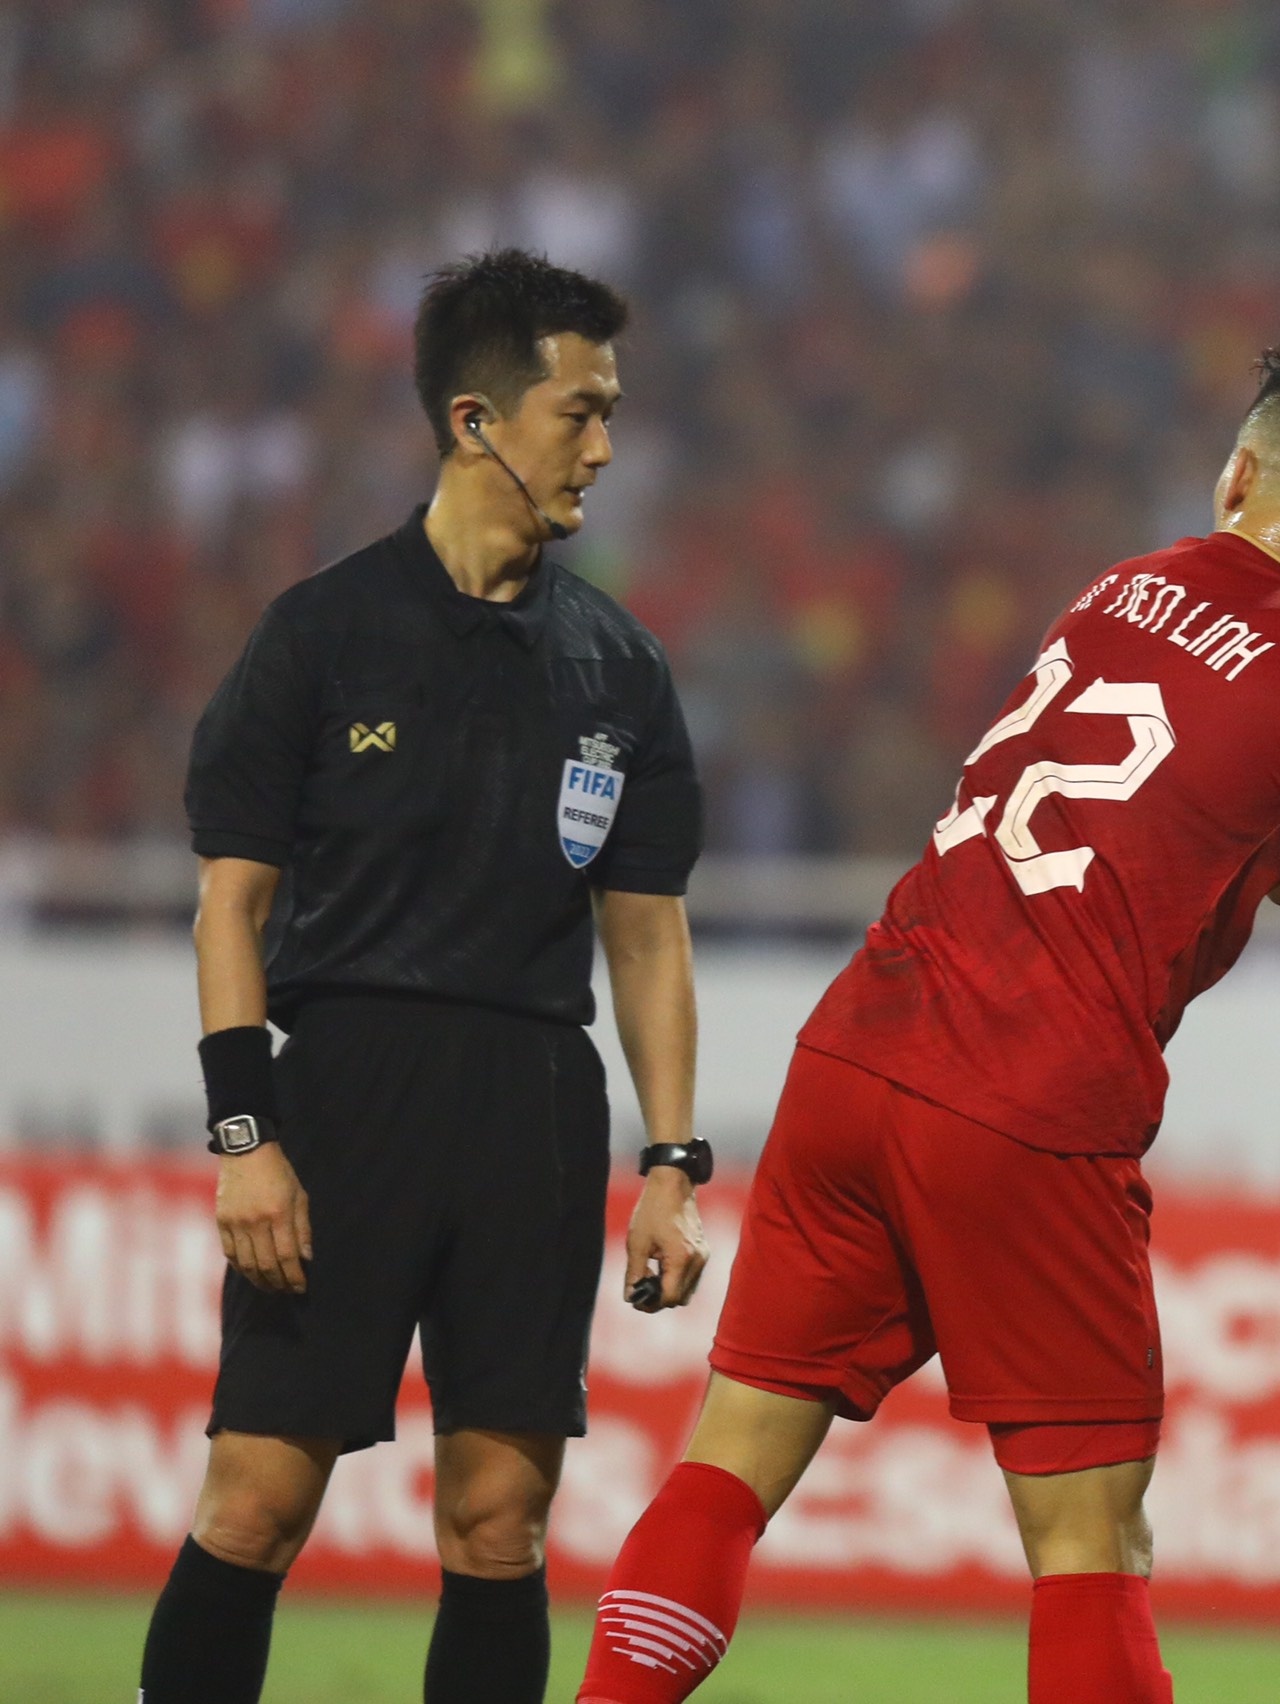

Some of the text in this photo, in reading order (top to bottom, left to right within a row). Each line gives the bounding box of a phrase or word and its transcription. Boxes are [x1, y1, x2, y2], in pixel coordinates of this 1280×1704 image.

[1166, 602, 1276, 682] LINH
[568, 766, 616, 801] FIFA
[933, 636, 1177, 896] 22
[563, 807, 610, 830] REFEREE
